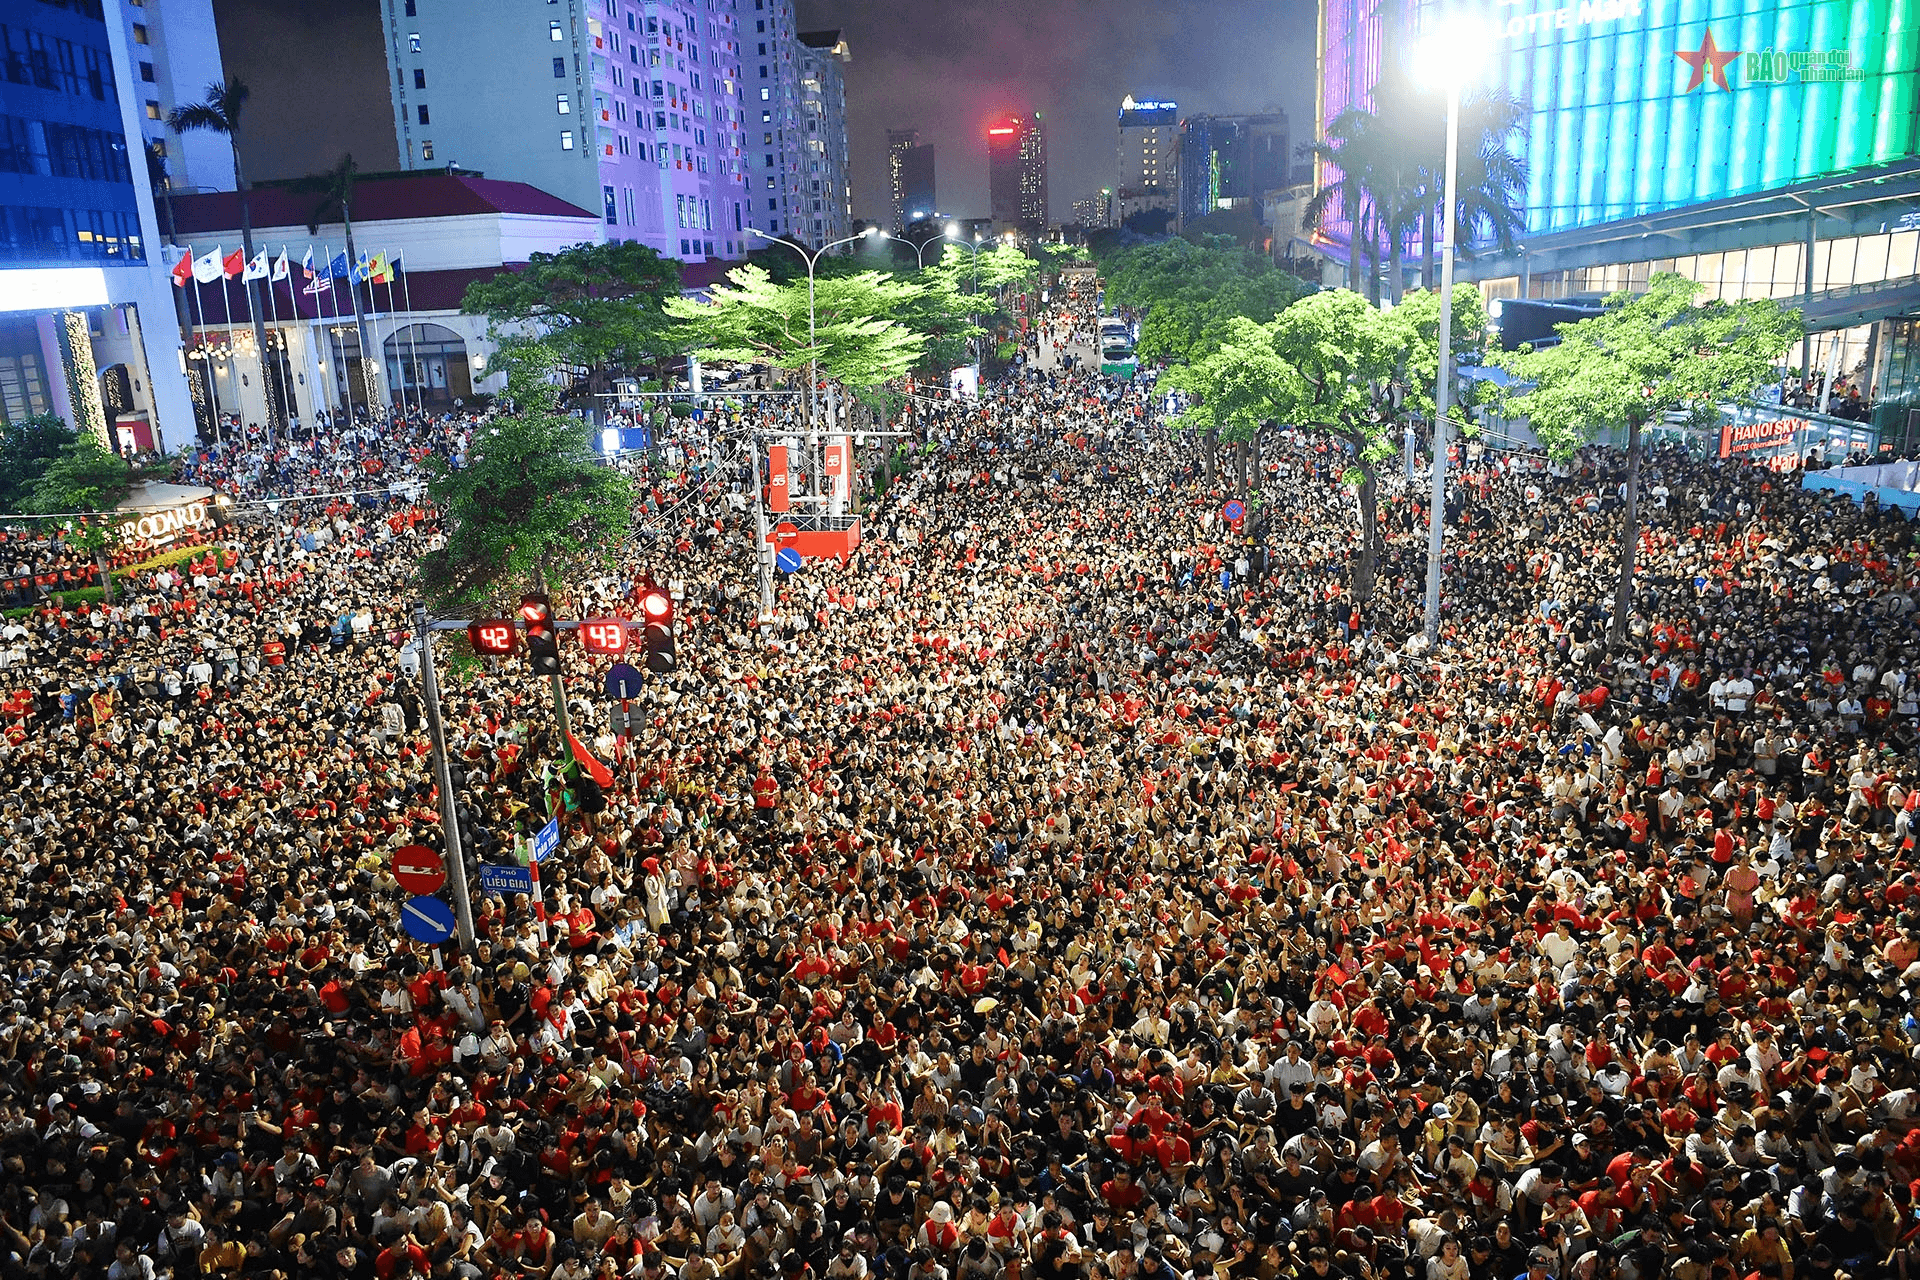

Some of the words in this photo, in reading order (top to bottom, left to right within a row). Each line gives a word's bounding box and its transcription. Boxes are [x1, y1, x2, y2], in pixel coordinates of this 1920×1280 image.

[1495, 8, 1570, 39] LOTTE
[1734, 422, 1773, 441] HANOI
[1774, 417, 1800, 435] SKY
[480, 627, 510, 649] 42
[589, 625, 622, 649] 43
[508, 878, 528, 889] GIAI
